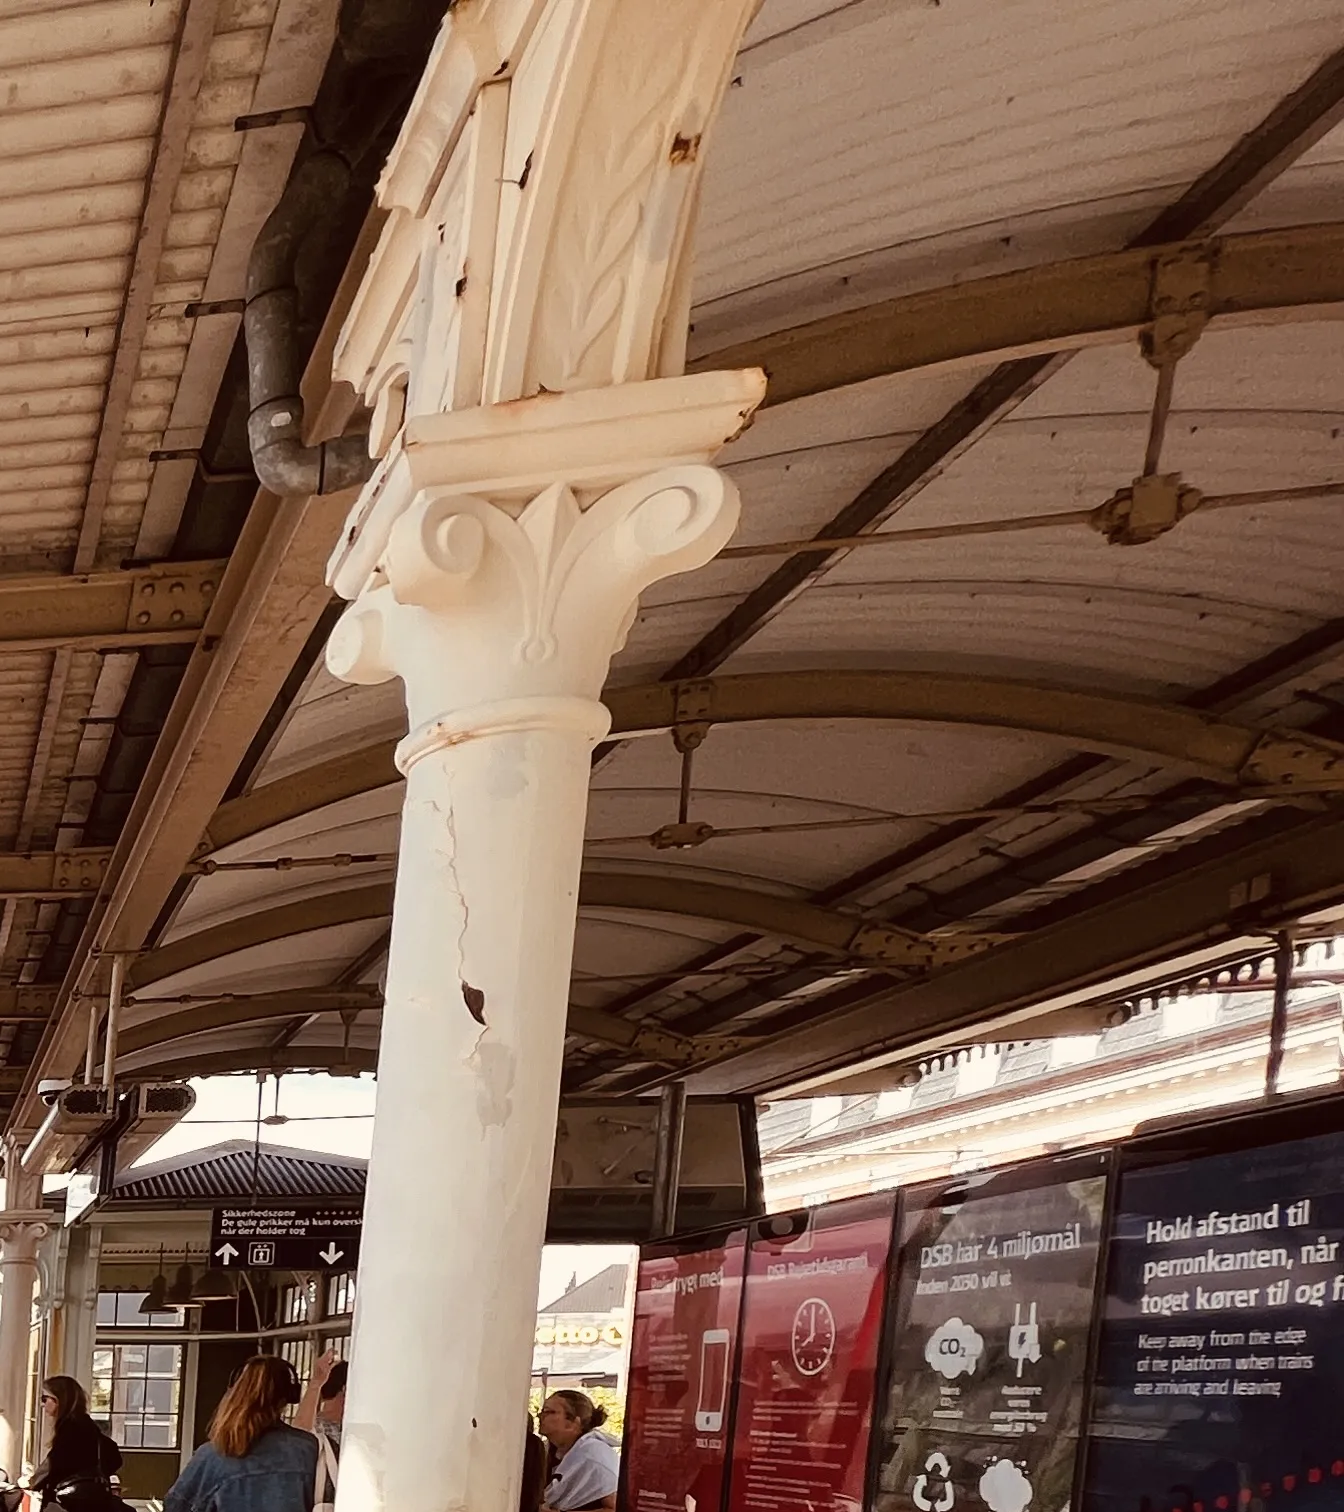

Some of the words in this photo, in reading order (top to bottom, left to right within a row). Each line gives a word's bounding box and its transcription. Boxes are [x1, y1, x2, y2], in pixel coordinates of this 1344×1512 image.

[221, 1210, 296, 1218] Sikkerhedszone
[221, 1219, 235, 1227] De
[237, 1219, 257, 1228] gule
[259, 1219, 293, 1227] prikker
[295, 1217, 310, 1226] må
[312, 1218, 331, 1226] kun
[1146, 1215, 1192, 1245] Hold
[1196, 1203, 1279, 1239] afstand
[1286, 1199, 1311, 1227] til
[220, 1227, 236, 1235] når
[238, 1227, 254, 1235] der
[256, 1227, 287, 1235] holder
[289, 1227, 306, 1236] tog
[920, 1243, 953, 1269] DSB
[956, 1241, 983, 1264] har
[986, 1237, 999, 1259] 4
[1002, 1222, 1081, 1261] miljømål
[1143, 1248, 1295, 1285] perronkanten,
[1300, 1235, 1339, 1264] når
[699, 1265, 723, 1288] med
[1141, 1290, 1190, 1316] toget
[1195, 1286, 1260, 1310] kører
[1267, 1279, 1290, 1306] til
[1295, 1281, 1327, 1307] og
[1138, 1334, 1167, 1351] Keep
[1168, 1334, 1206, 1350] away
[1210, 1330, 1246, 1346] from
[1249, 1329, 1272, 1345] the
[1274, 1326, 1308, 1346] edge
[1171, 1354, 1233, 1374] platform
[1235, 1353, 1276, 1371] when
[1278, 1352, 1315, 1370] trains
[1134, 1381, 1154, 1396] are
[1154, 1378, 1202, 1397] arriving
[1203, 1379, 1230, 1396] and
[1233, 1378, 1282, 1398] leaving
